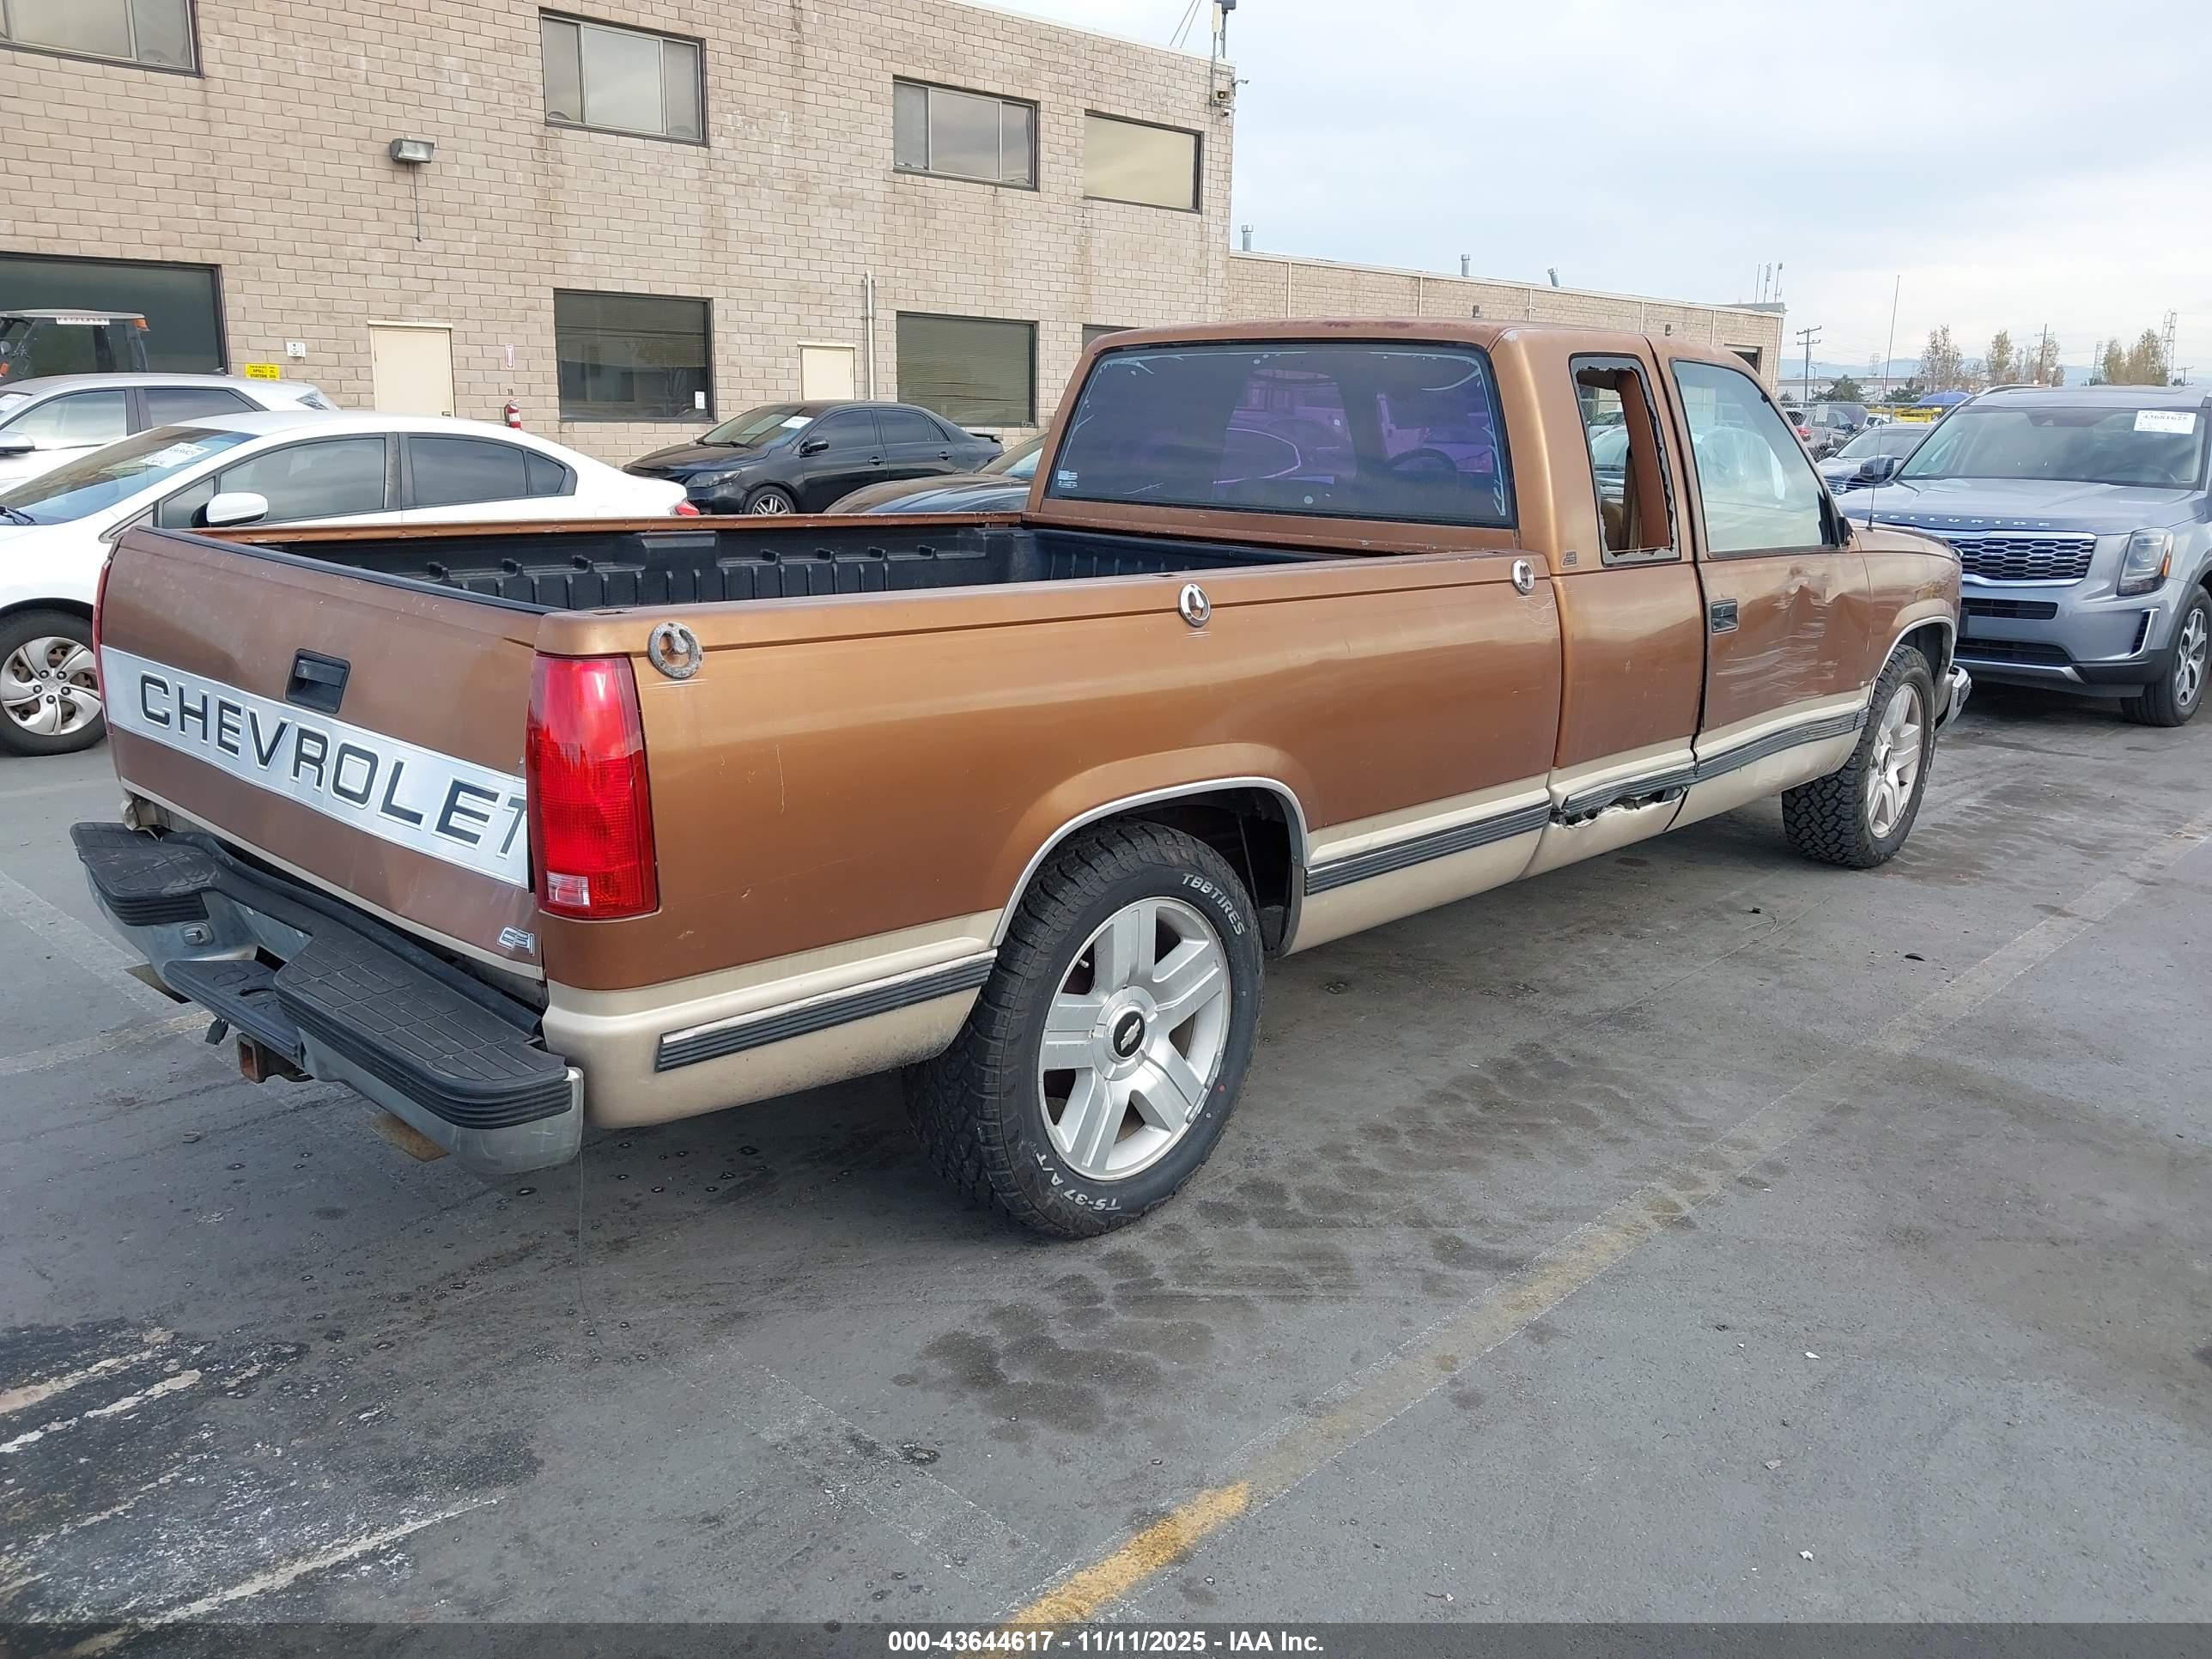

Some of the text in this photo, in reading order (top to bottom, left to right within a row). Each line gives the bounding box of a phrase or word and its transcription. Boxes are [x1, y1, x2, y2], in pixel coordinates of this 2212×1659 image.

[1872, 514, 2051, 527] TELLURIDE
[1036, 1152, 1122, 1212] TS-37 A/T
